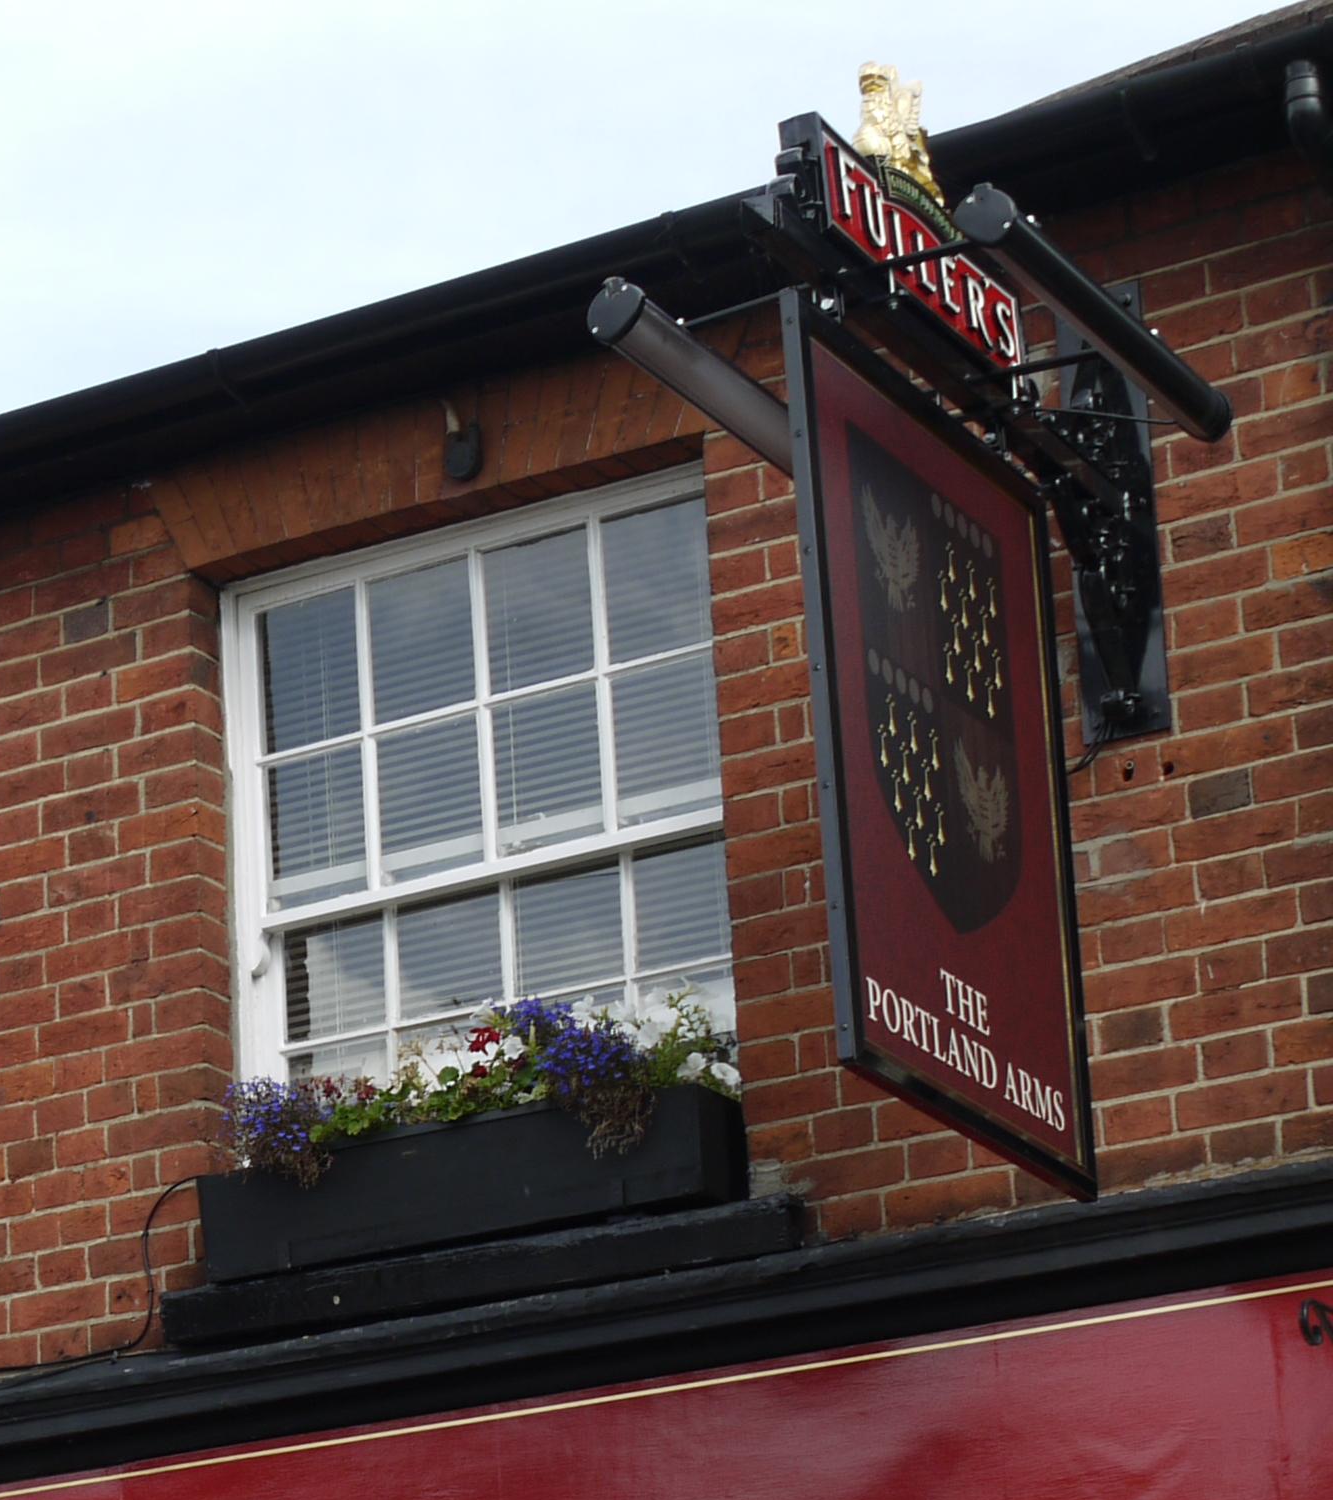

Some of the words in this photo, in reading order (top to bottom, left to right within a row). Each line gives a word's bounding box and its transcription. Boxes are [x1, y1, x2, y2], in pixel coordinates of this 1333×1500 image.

[865, 976, 998, 1090] PORTLAND
[1004, 1062, 1066, 1131] ARMS
[940, 967, 990, 1036] THE
